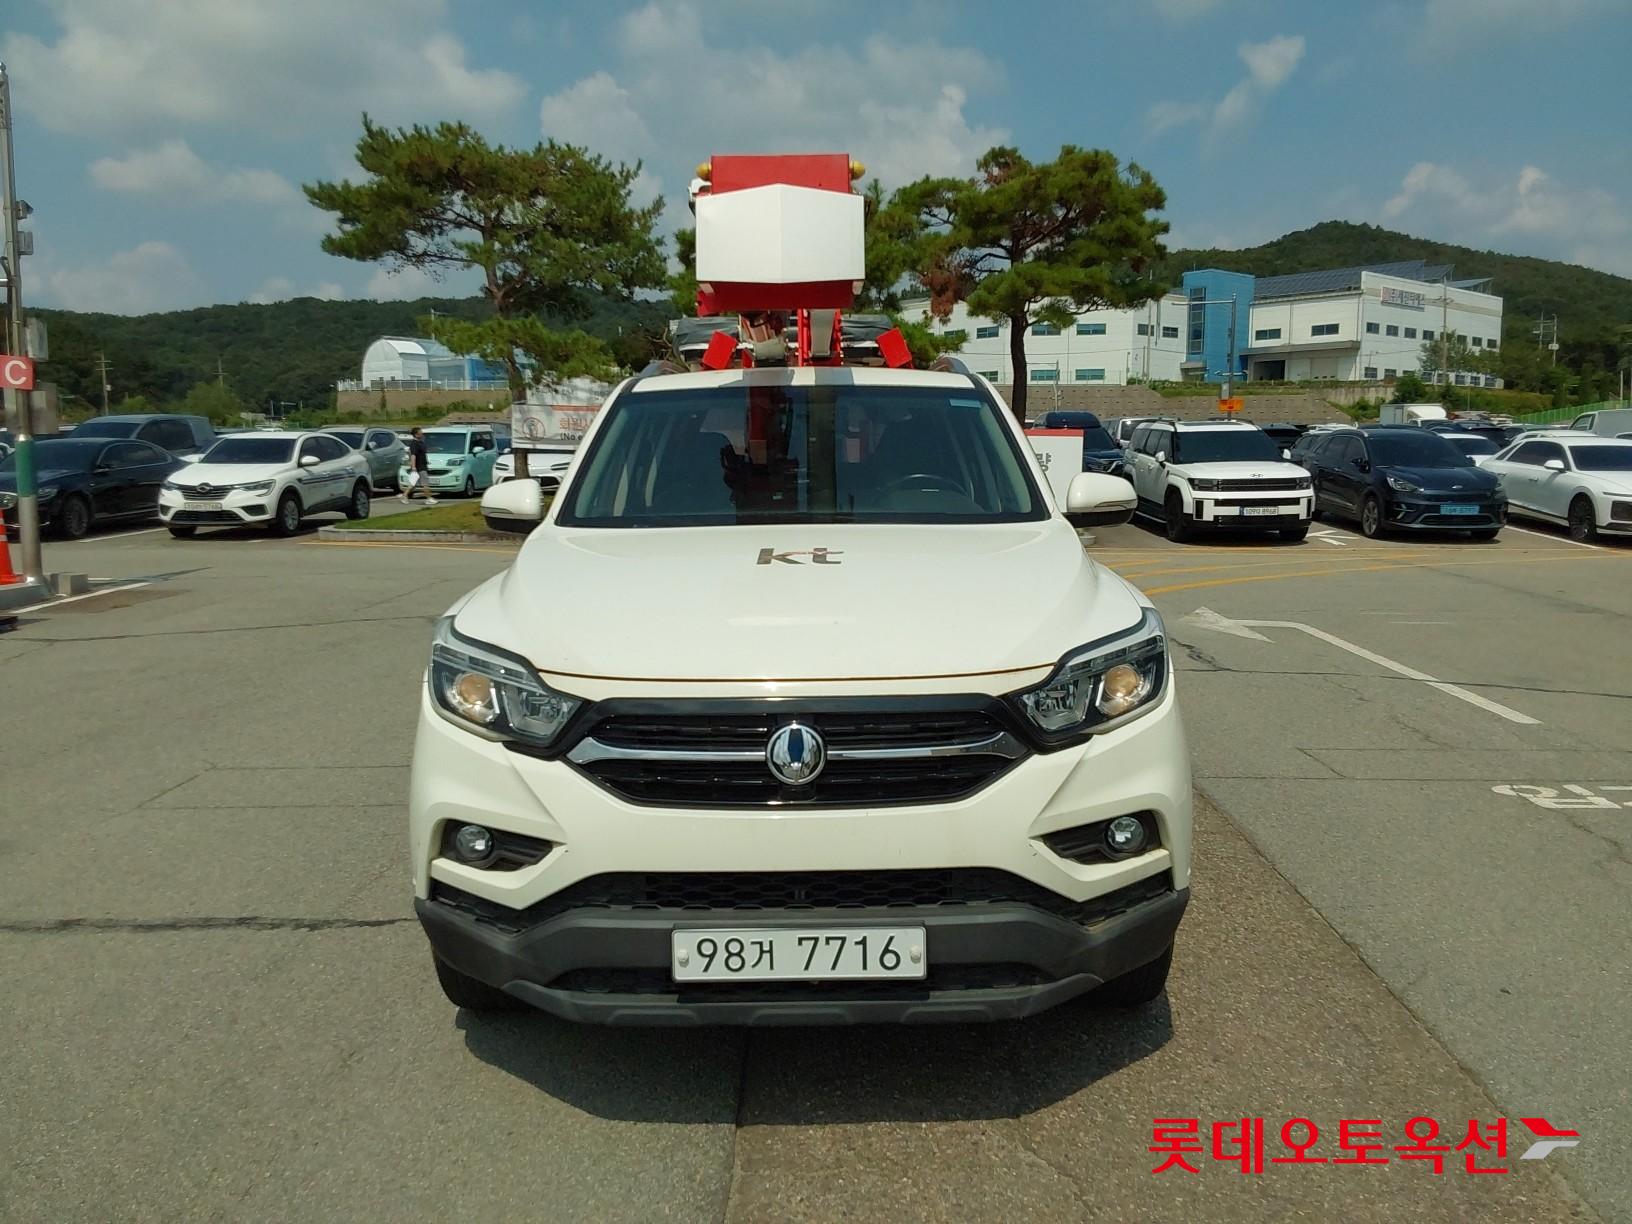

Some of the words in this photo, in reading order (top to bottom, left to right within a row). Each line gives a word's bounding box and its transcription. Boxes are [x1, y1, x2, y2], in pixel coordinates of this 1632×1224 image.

[4, 359, 27, 385] C
[1036, 452, 1052, 472] 량
[756, 547, 844, 565] kt
[1491, 784, 1632, 809] 입
[696, 937, 775, 973] 98거
[797, 935, 902, 971] 7716
